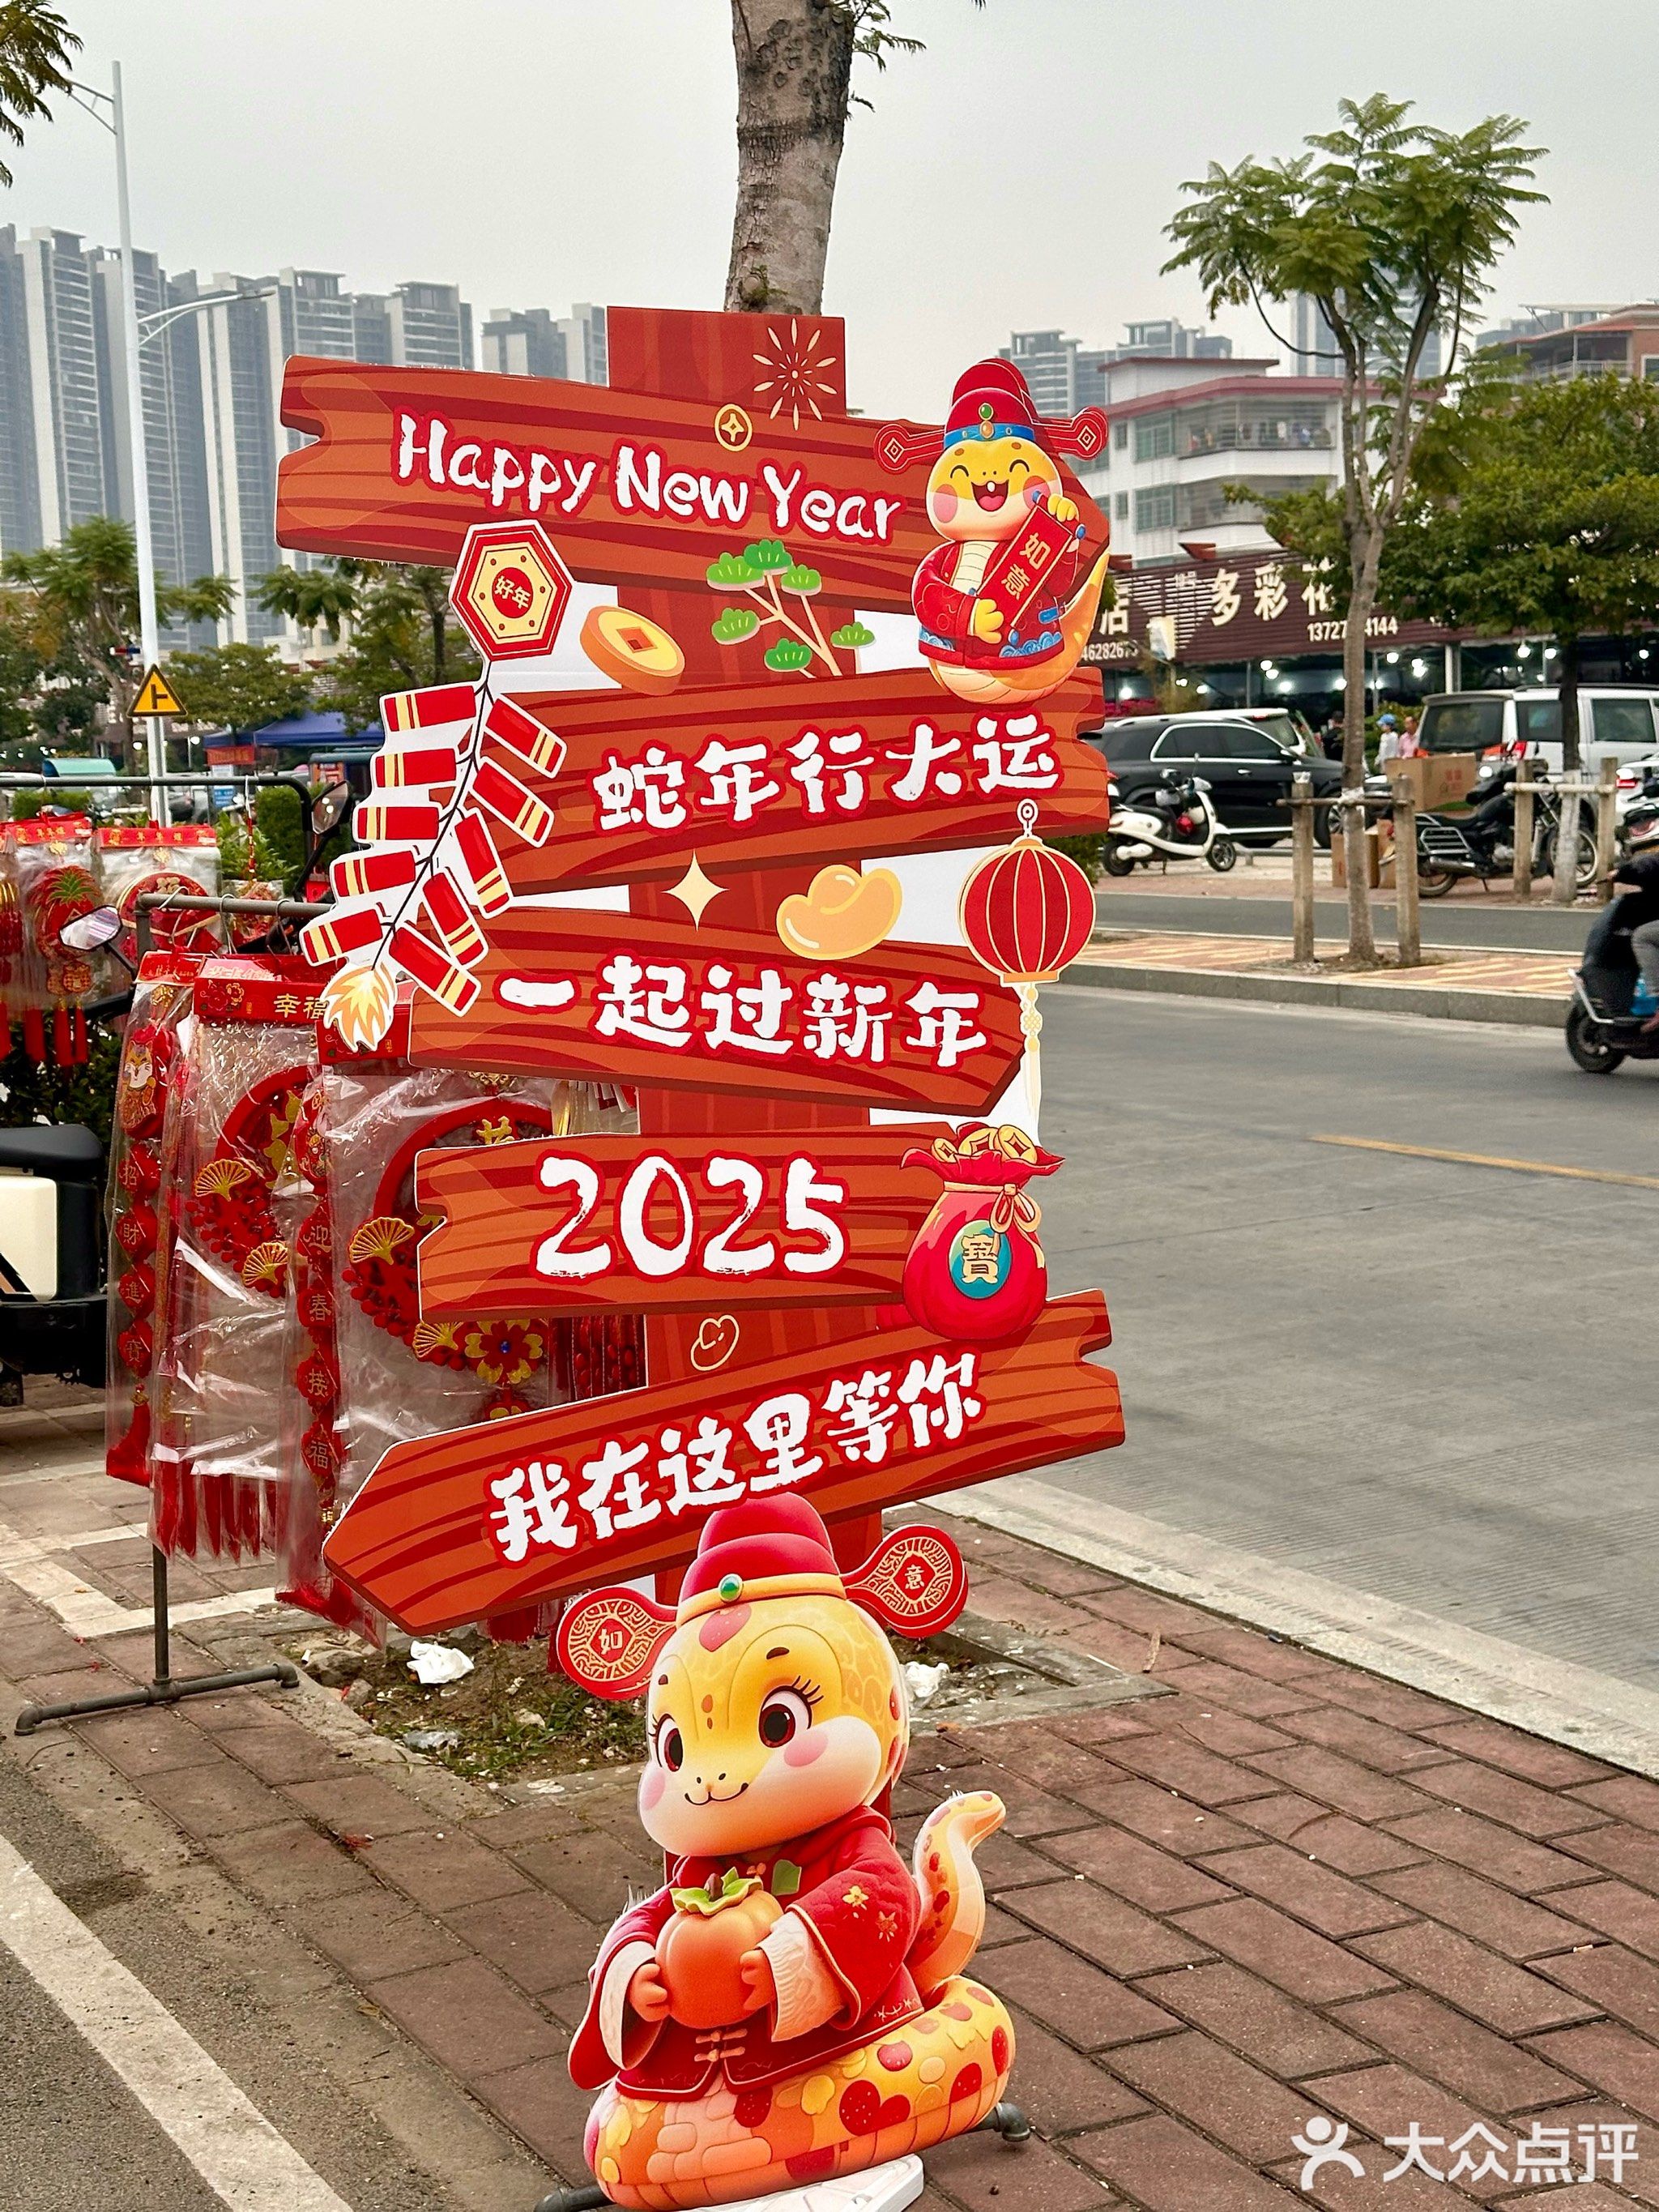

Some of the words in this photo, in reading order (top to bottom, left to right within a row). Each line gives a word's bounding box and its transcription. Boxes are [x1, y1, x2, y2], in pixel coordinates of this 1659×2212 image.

[397, 413, 596, 515] Happy
[615, 445, 749, 523] New
[762, 465, 904, 540] Year
[493, 574, 532, 609] 好年
[1000, 532, 1051, 600] 如意
[1307, 615, 1399, 643] 137274144
[591, 713, 1060, 831] 蛇年行大运
[273, 993, 327, 1019] 幸福
[497, 954, 987, 1068] 一起过新年
[535, 1155, 845, 1278] 2025
[488, 1352, 983, 1562] 我在这里等你
[904, 1565, 925, 1591] 意
[599, 1629, 623, 1655] 如
